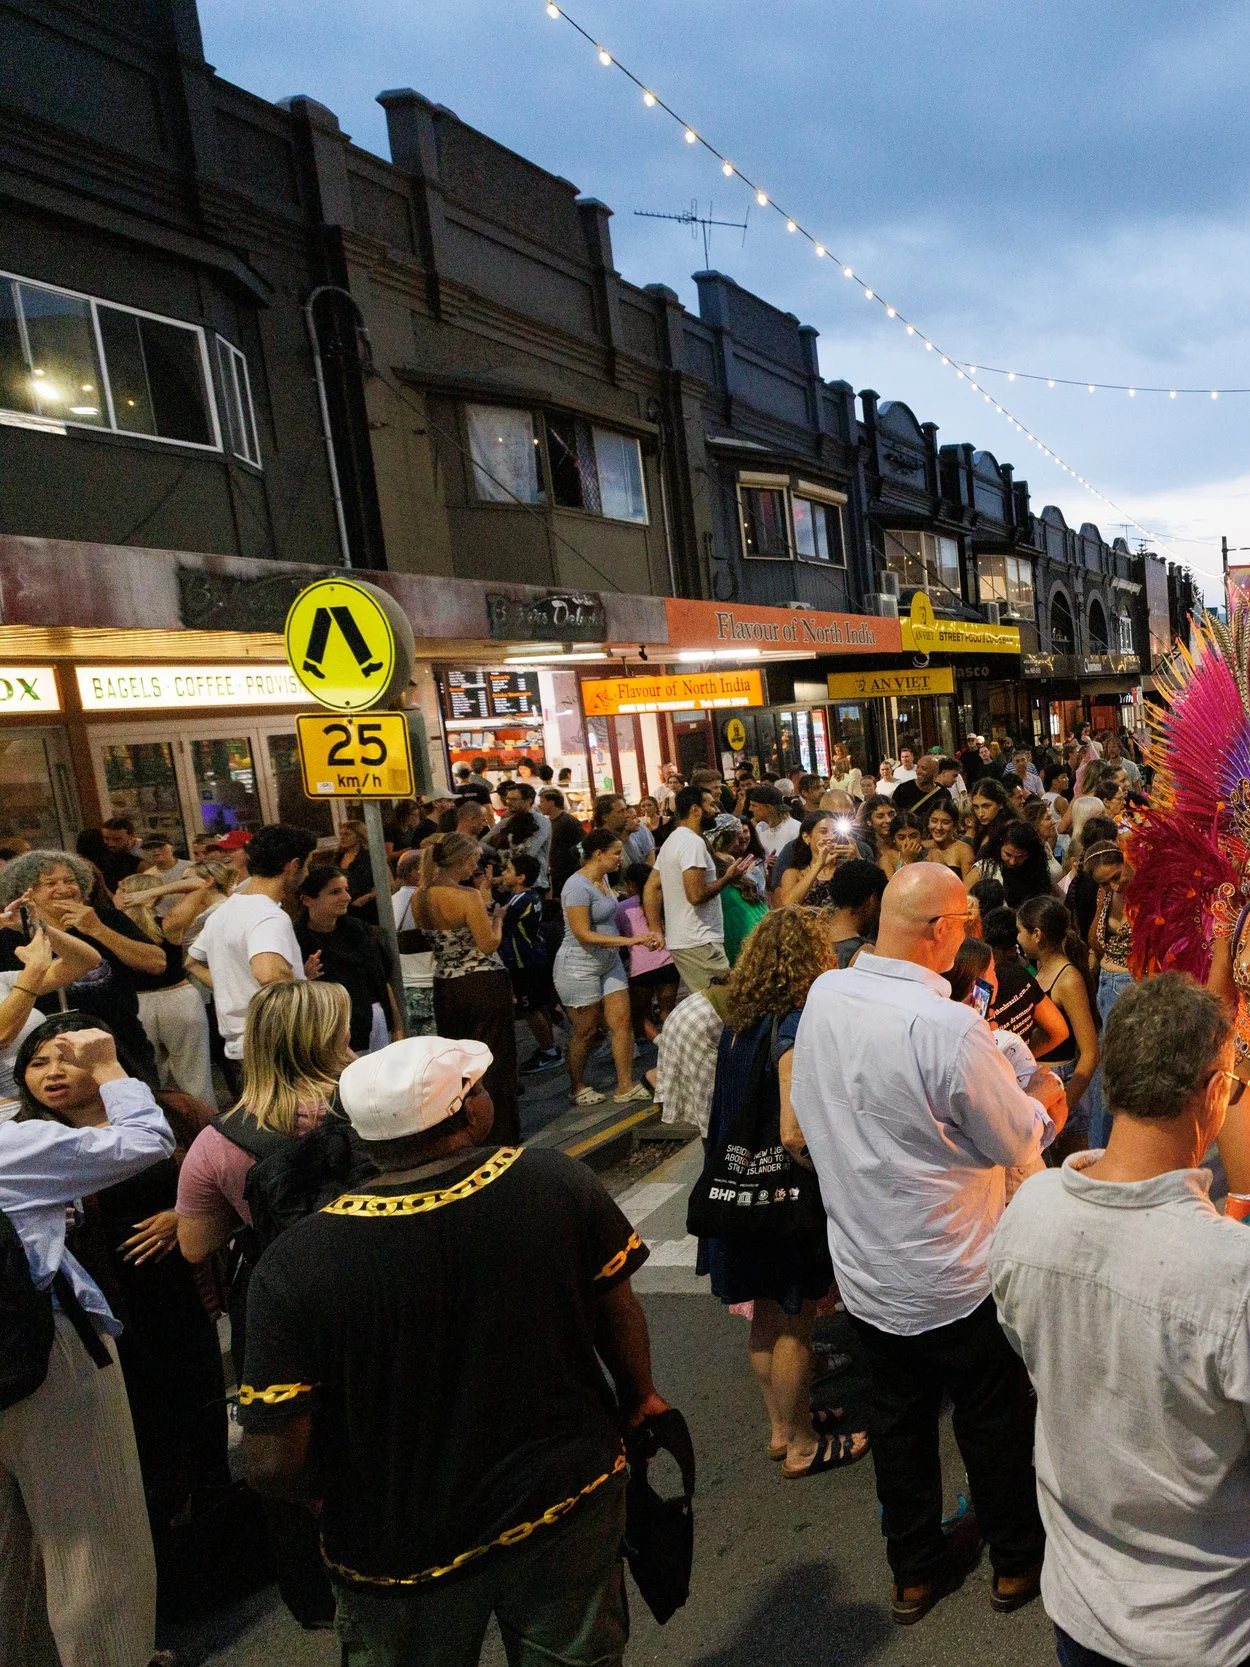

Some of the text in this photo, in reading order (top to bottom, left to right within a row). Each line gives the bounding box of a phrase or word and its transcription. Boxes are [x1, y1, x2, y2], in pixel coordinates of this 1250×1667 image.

[715, 611, 876, 645] Flavour of North India
[939, 631, 963, 642] STREET
[92, 677, 162, 699] BAGELS
[175, 676, 236, 697] COFFEE
[617, 678, 751, 699] Flavour of North India
[871, 676, 931, 690] AN VIET
[322, 723, 388, 766] 25
[337, 772, 382, 788] km/h
[759, 1156, 773, 1166] AND
[746, 1163, 781, 1176] ISLANDER
[708, 1187, 736, 1202] BHP
